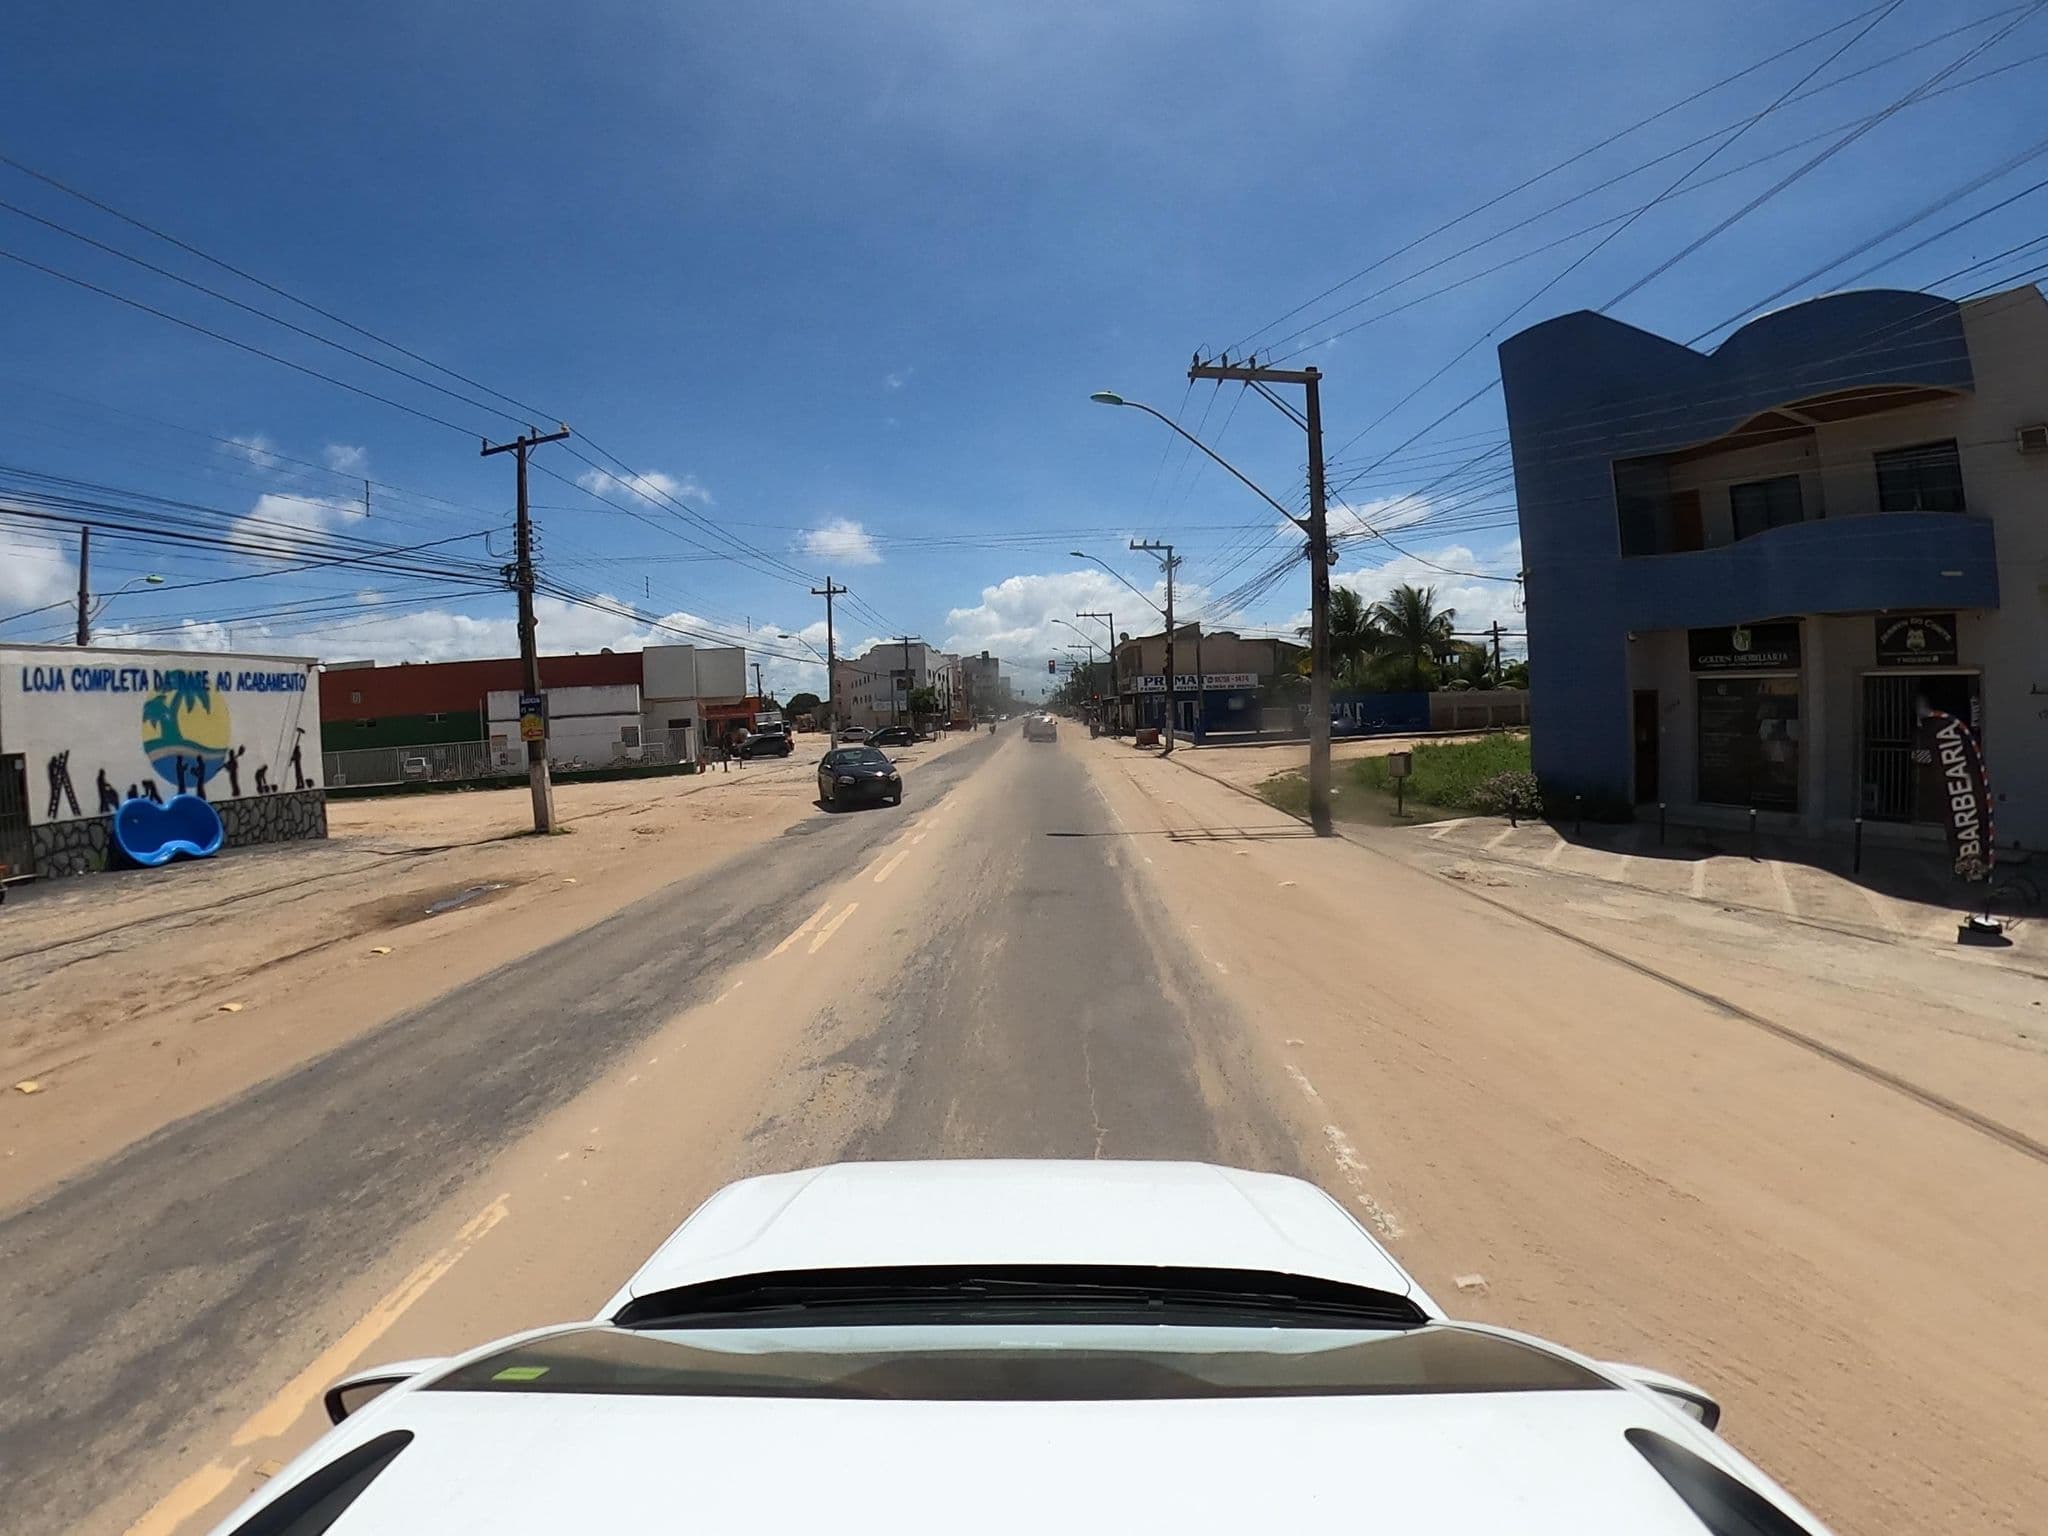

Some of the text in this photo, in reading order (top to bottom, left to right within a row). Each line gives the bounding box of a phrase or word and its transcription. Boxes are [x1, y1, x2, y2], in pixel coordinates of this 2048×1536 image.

[22, 667, 65, 692] LOJA
[71, 668, 148, 692] COMPLETA
[216, 672, 232, 691] AO
[236, 672, 306, 692] ACABAMENTO
[1144, 675, 1208, 687] PRMAT
[1936, 718, 1982, 859] BARBEARIA
